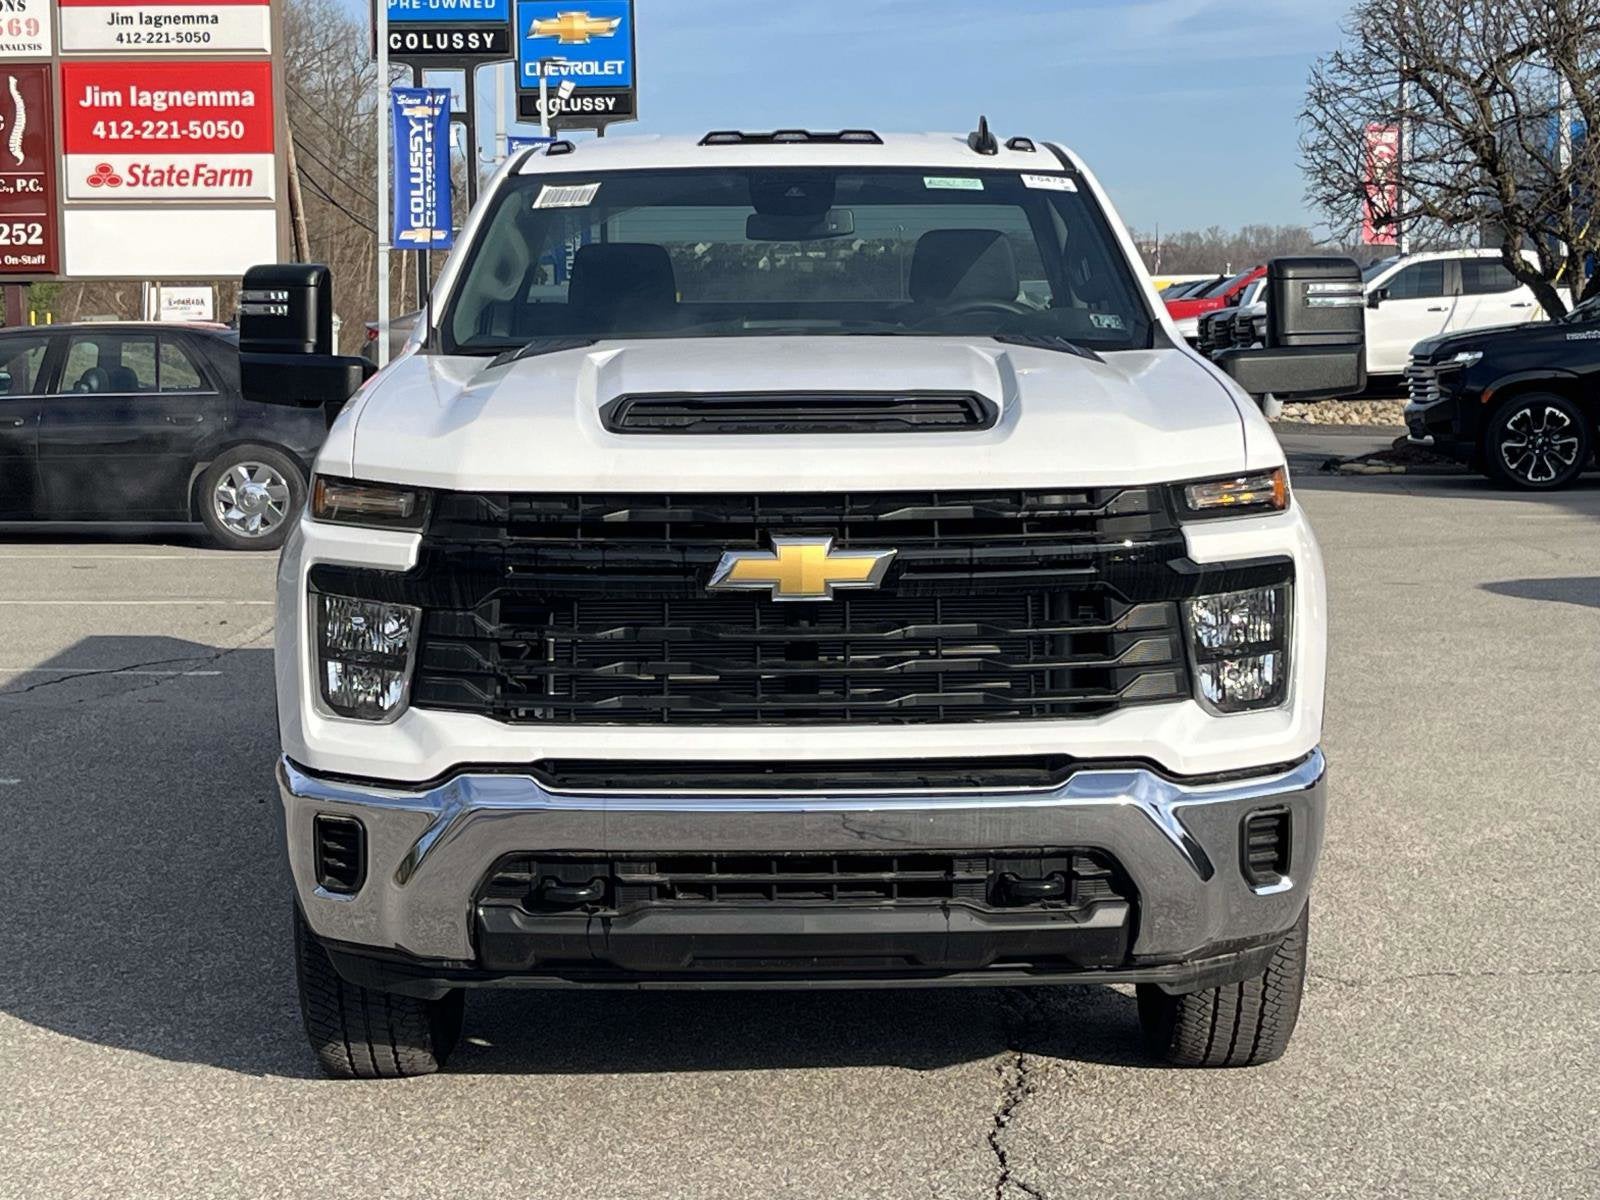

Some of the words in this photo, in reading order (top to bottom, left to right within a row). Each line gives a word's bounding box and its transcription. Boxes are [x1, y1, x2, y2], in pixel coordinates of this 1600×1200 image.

[0, 18, 40, 37] 69
[107, 12, 134, 25] Jim
[139, 12, 219, 27] Iagnemma
[115, 32, 211, 43] 412-221-5050
[389, 33, 495, 49] COLUSSY
[79, 85, 122, 107] Jim
[130, 85, 255, 111] Iagnemma
[92, 120, 245, 139] 412-221-5050
[409, 119, 424, 228] COLUSSY
[16, 178, 43, 192] P.C.
[4, 254, 46, 266] On-Staff
